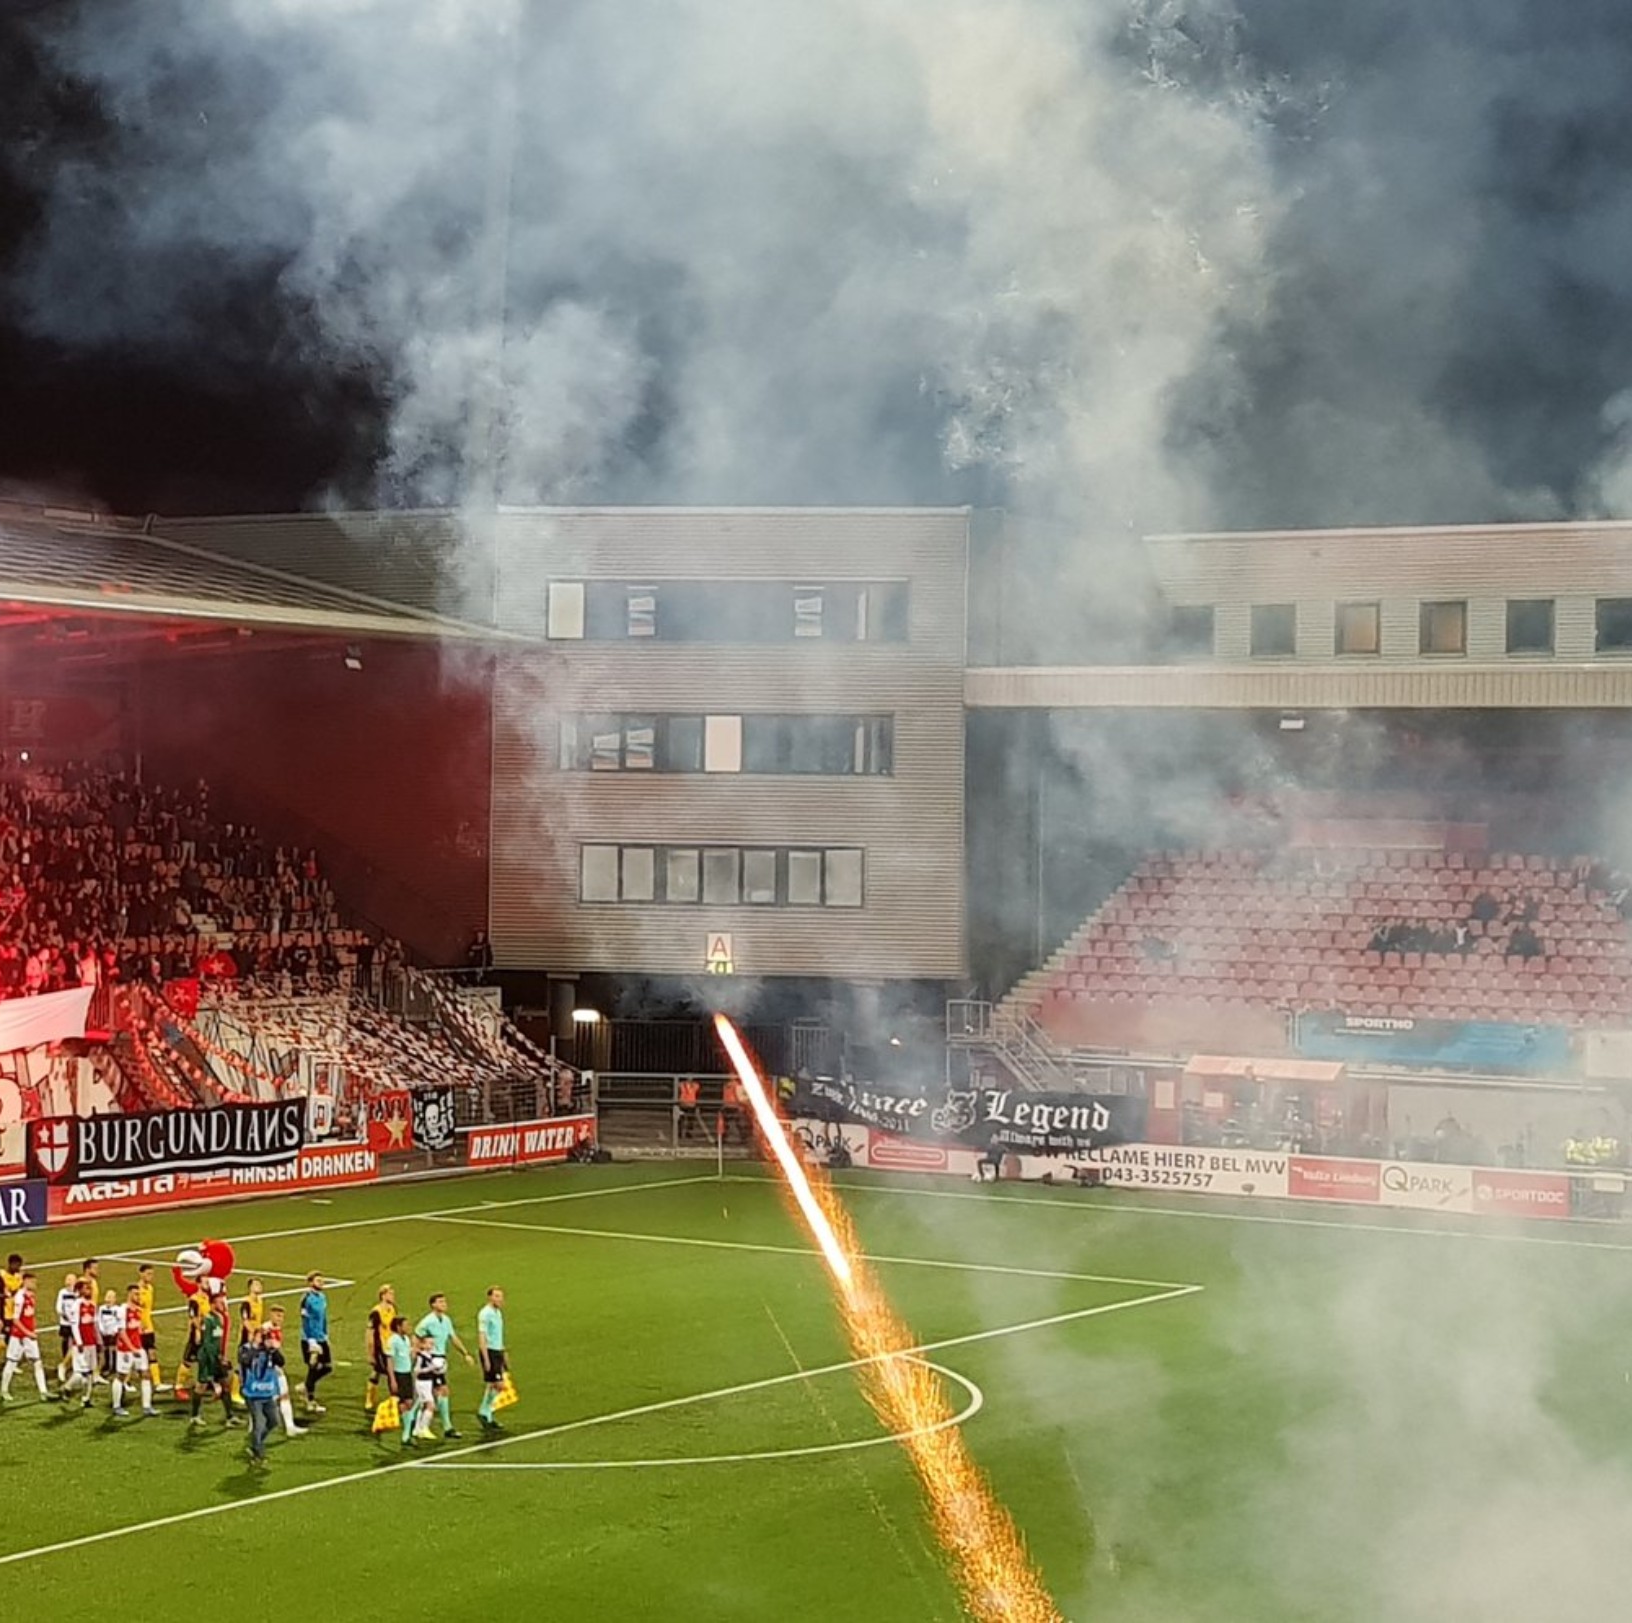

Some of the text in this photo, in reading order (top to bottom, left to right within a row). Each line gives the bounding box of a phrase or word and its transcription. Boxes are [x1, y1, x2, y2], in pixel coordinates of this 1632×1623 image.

[711, 936, 728, 957] A
[983, 1089, 1112, 1134] Legend
[78, 1105, 300, 1165] BURGUNDIANS
[470, 1126, 575, 1160] DRINK WATER
[301, 1151, 376, 1179] DRANKEN
[1102, 1167, 1213, 1188] 043-3525757
[1154, 1152, 1204, 1170] HIER?
[1210, 1159, 1240, 1172] BEL
[1246, 1159, 1285, 1176] MVV
[1382, 1166, 1453, 1193] Q PARK
